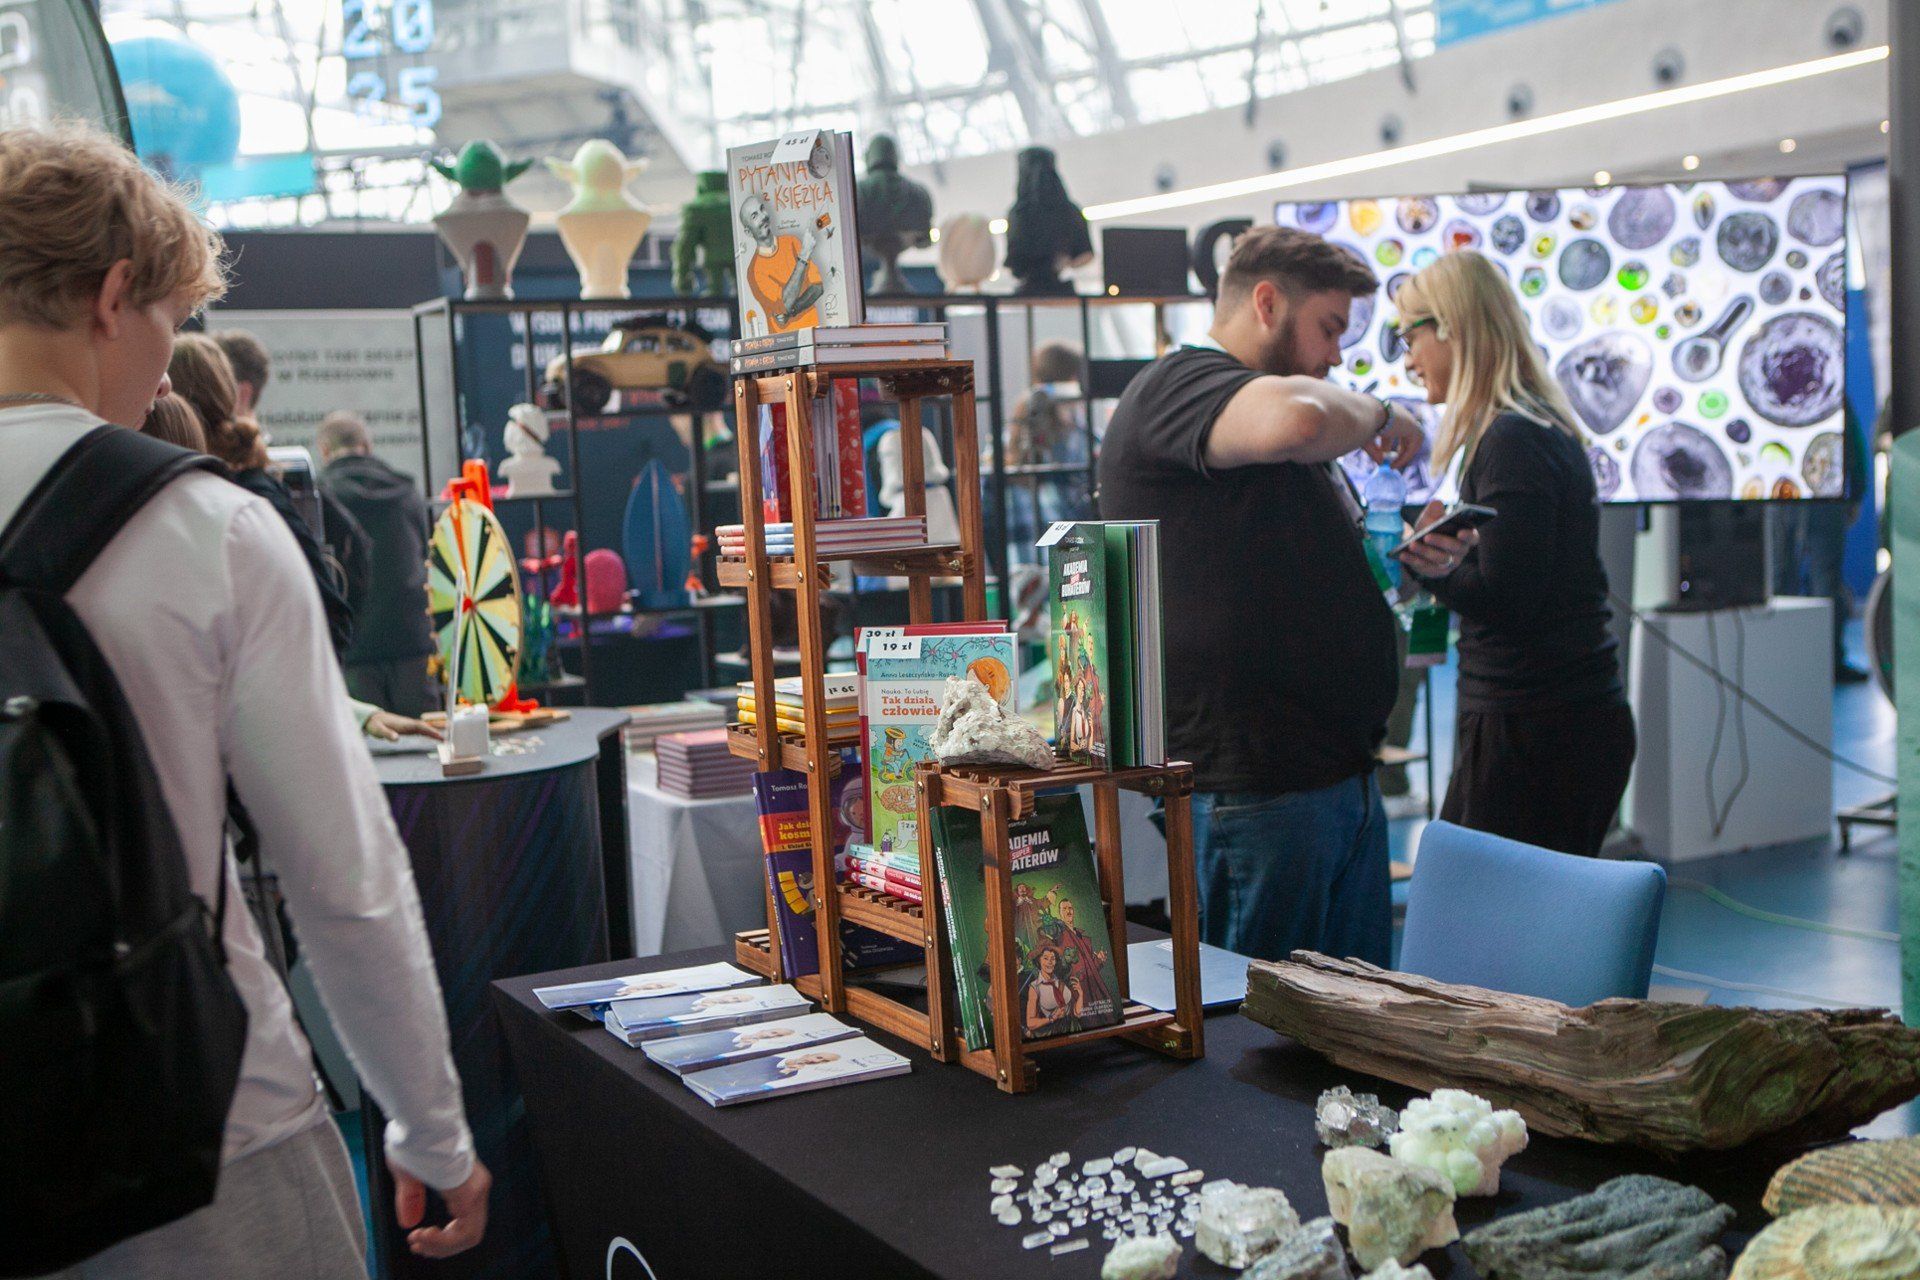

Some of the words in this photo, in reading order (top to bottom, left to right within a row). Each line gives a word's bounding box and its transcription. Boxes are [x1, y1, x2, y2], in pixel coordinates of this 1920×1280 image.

[738, 160, 808, 195] PYTANIA
[866, 630, 881, 638] 39
[885, 630, 896, 638] zł
[883, 643, 897, 651] 19
[902, 642, 912, 651] zł
[882, 696, 901, 704] Tak
[904, 695, 935, 704] działa
[881, 705, 941, 716] człowiek
[771, 784, 797, 792] Tomasz
[779, 822, 795, 831] Jak
[779, 830, 811, 840] kosm
[1008, 830, 1050, 851] ADEMIA
[1011, 848, 1059, 871] ATERÓW
